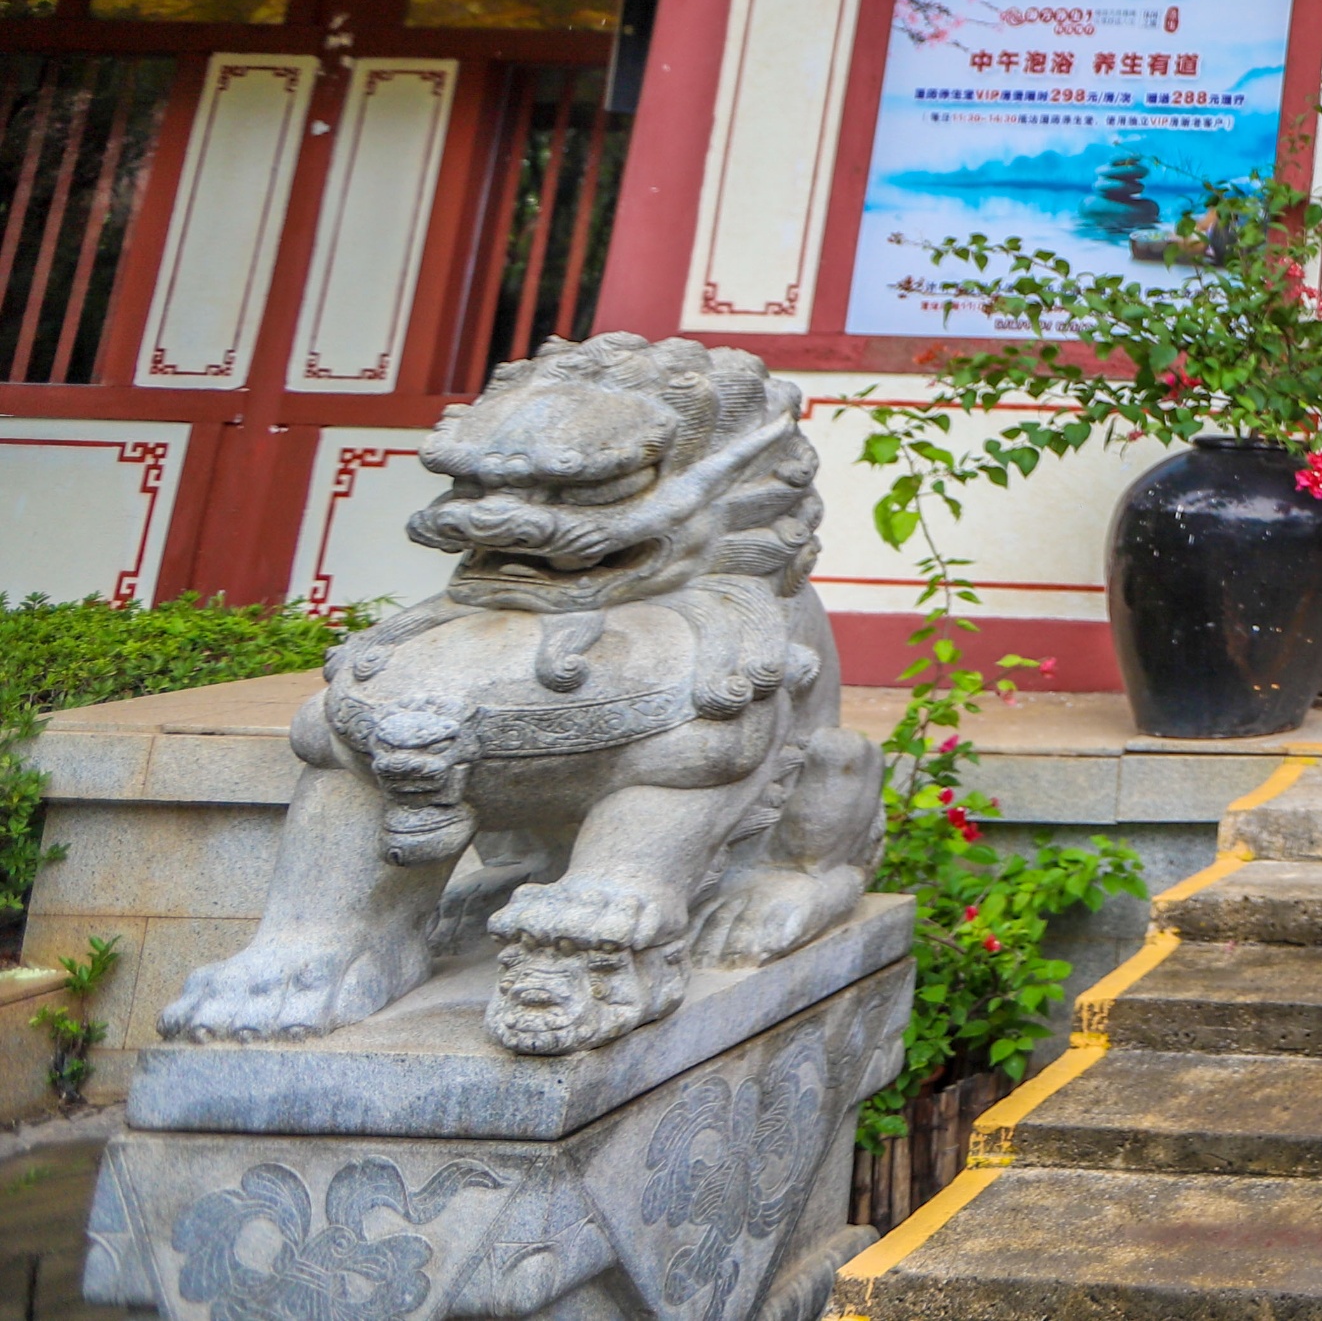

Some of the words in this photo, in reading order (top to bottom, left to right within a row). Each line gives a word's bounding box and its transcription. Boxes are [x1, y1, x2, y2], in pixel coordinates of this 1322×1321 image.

[969, 48, 1075, 75] 中午泡浴
[1093, 51, 1200, 77] 养生有道
